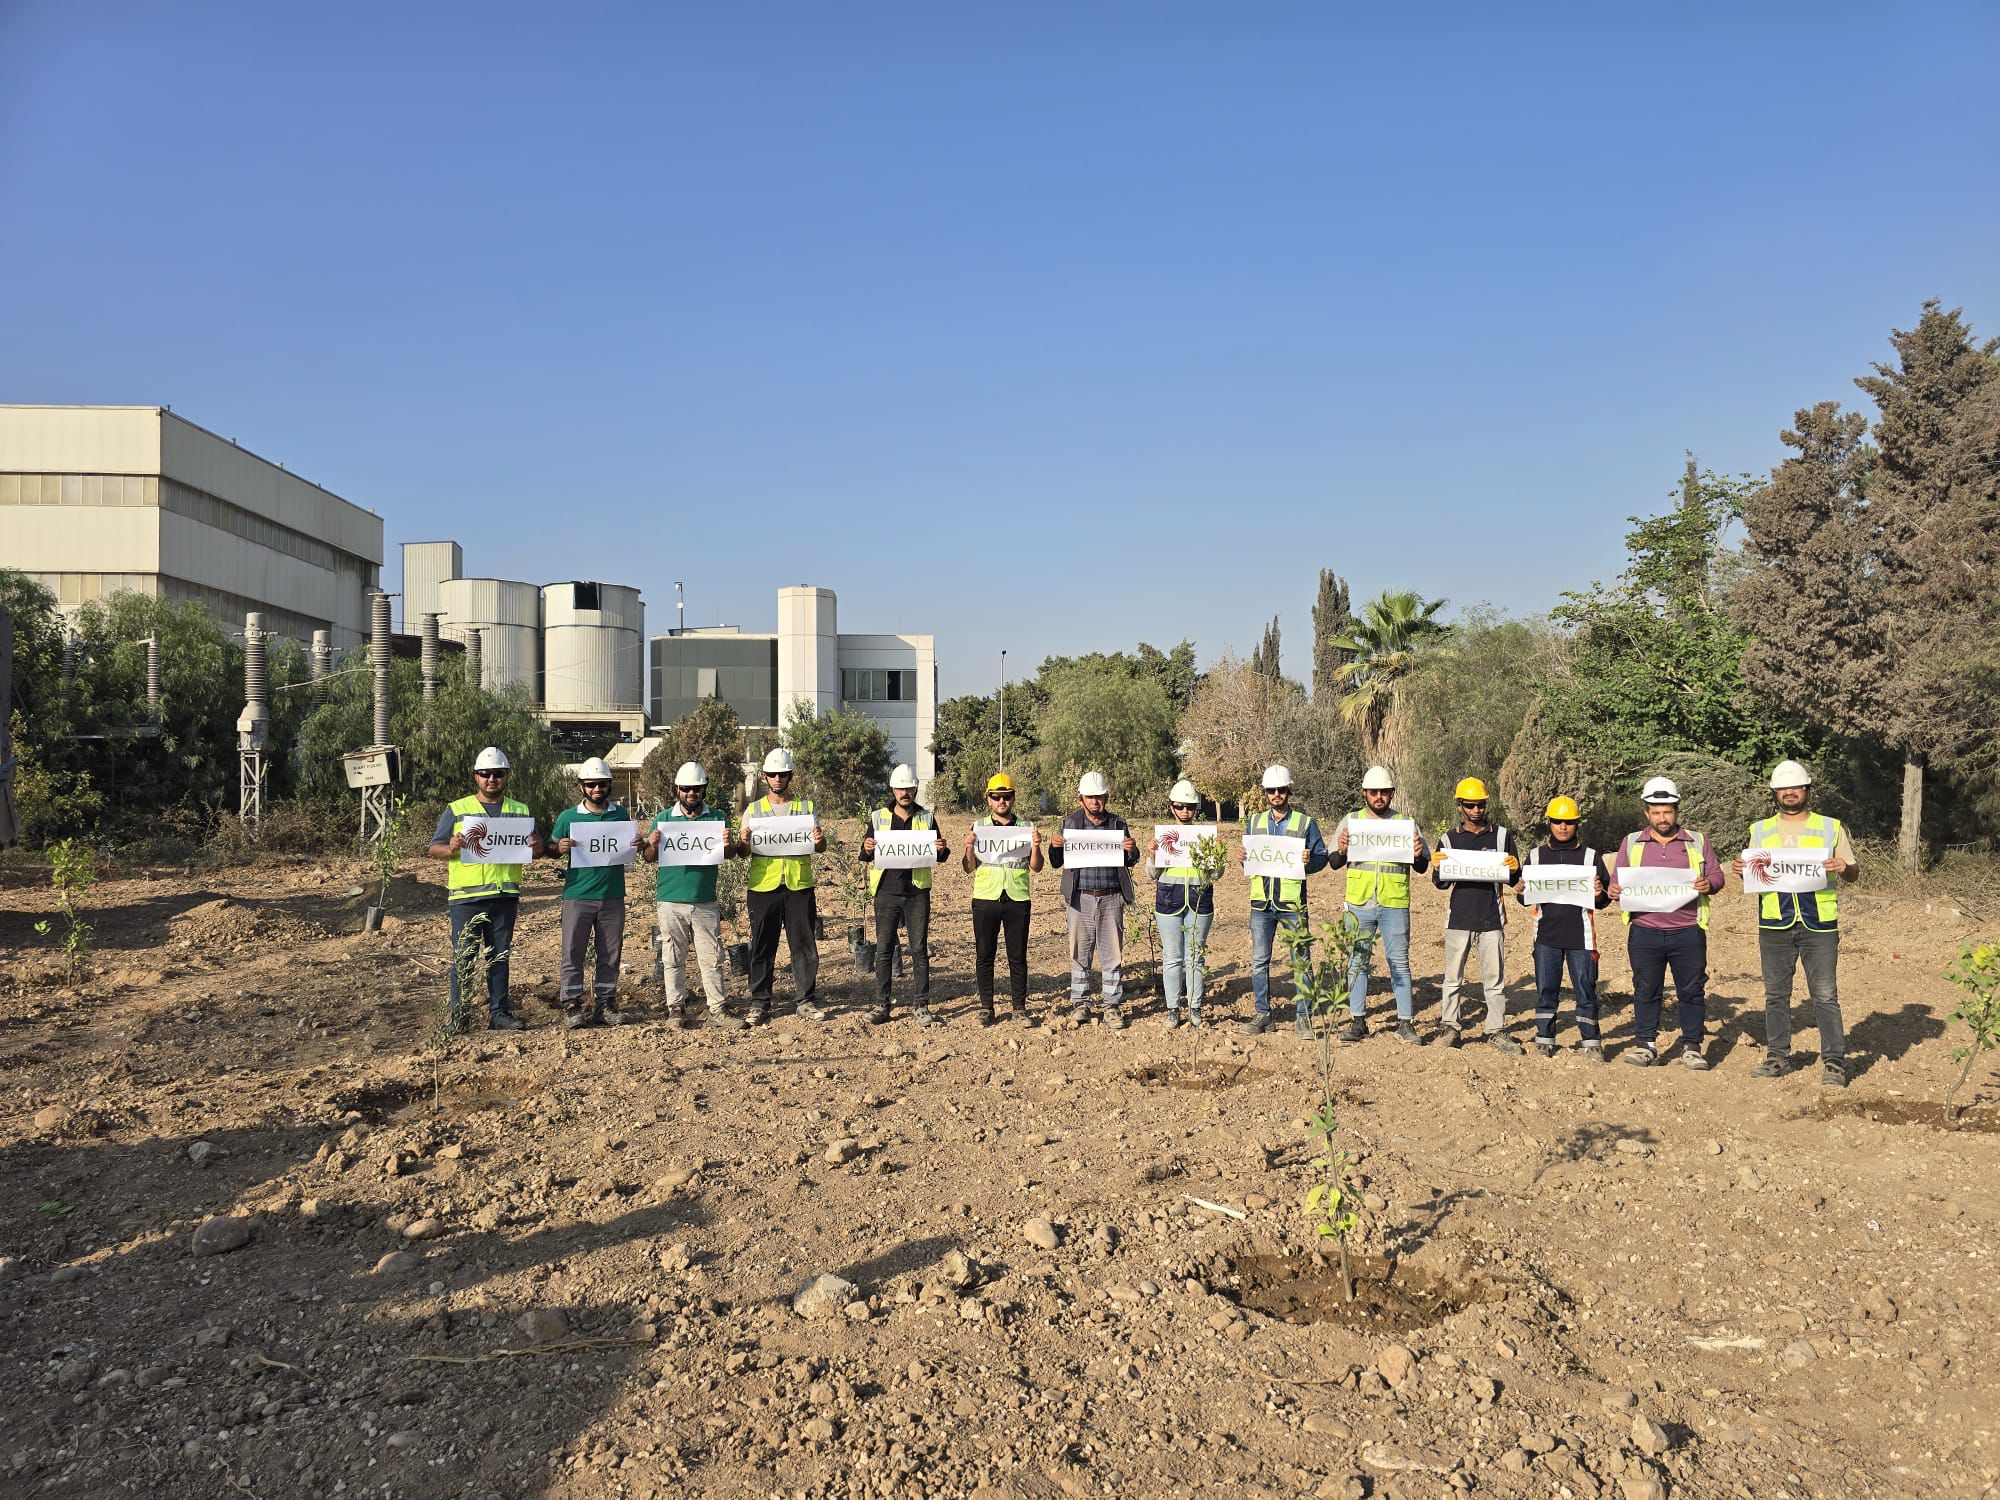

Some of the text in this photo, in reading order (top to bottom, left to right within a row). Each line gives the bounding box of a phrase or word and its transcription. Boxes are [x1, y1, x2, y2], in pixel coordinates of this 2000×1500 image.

[486, 832, 529, 846] SİNTEK
[590, 835, 618, 853] BİR
[663, 832, 715, 854] AĞAÇ
[752, 831, 813, 846] DİKMEK
[977, 839, 1029, 853] UMUT
[1349, 832, 1412, 848] DİKMEK
[877, 843, 933, 856] YARINA
[1248, 845, 1296, 868] AĞAÇ
[1773, 861, 1820, 877] SİNTEK
[1529, 879, 1589, 892] NEFES
